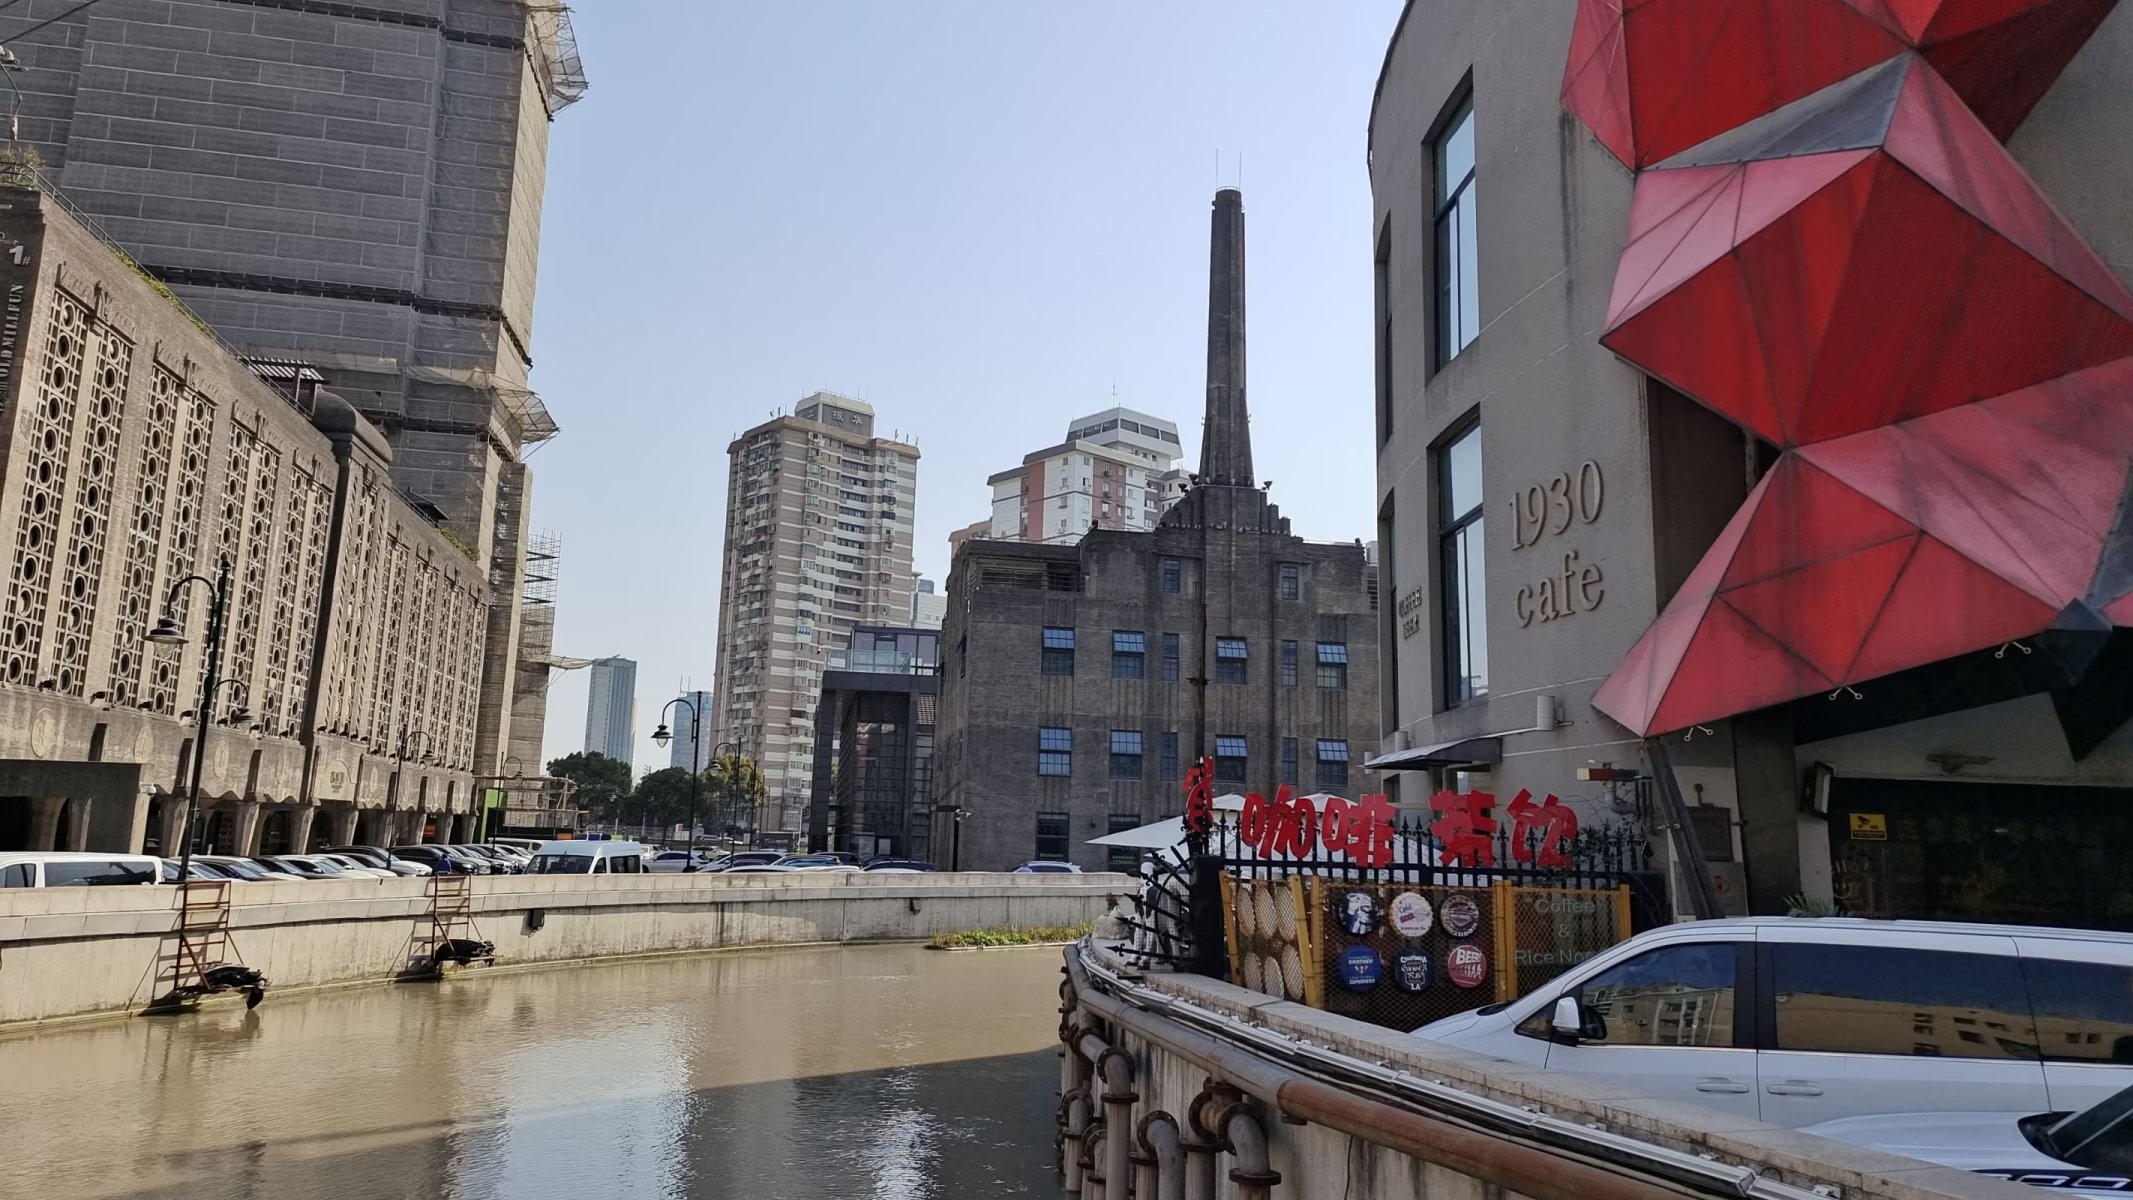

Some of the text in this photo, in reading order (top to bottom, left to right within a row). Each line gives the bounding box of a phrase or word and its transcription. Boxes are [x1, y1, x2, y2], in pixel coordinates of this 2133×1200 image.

[1509, 460, 1605, 551] 1930
[1516, 549, 1605, 628] cafe
[1536, 898, 1595, 913] Coffee
[1558, 923, 1570, 937] &
[1514, 949, 1555, 966] Rice
